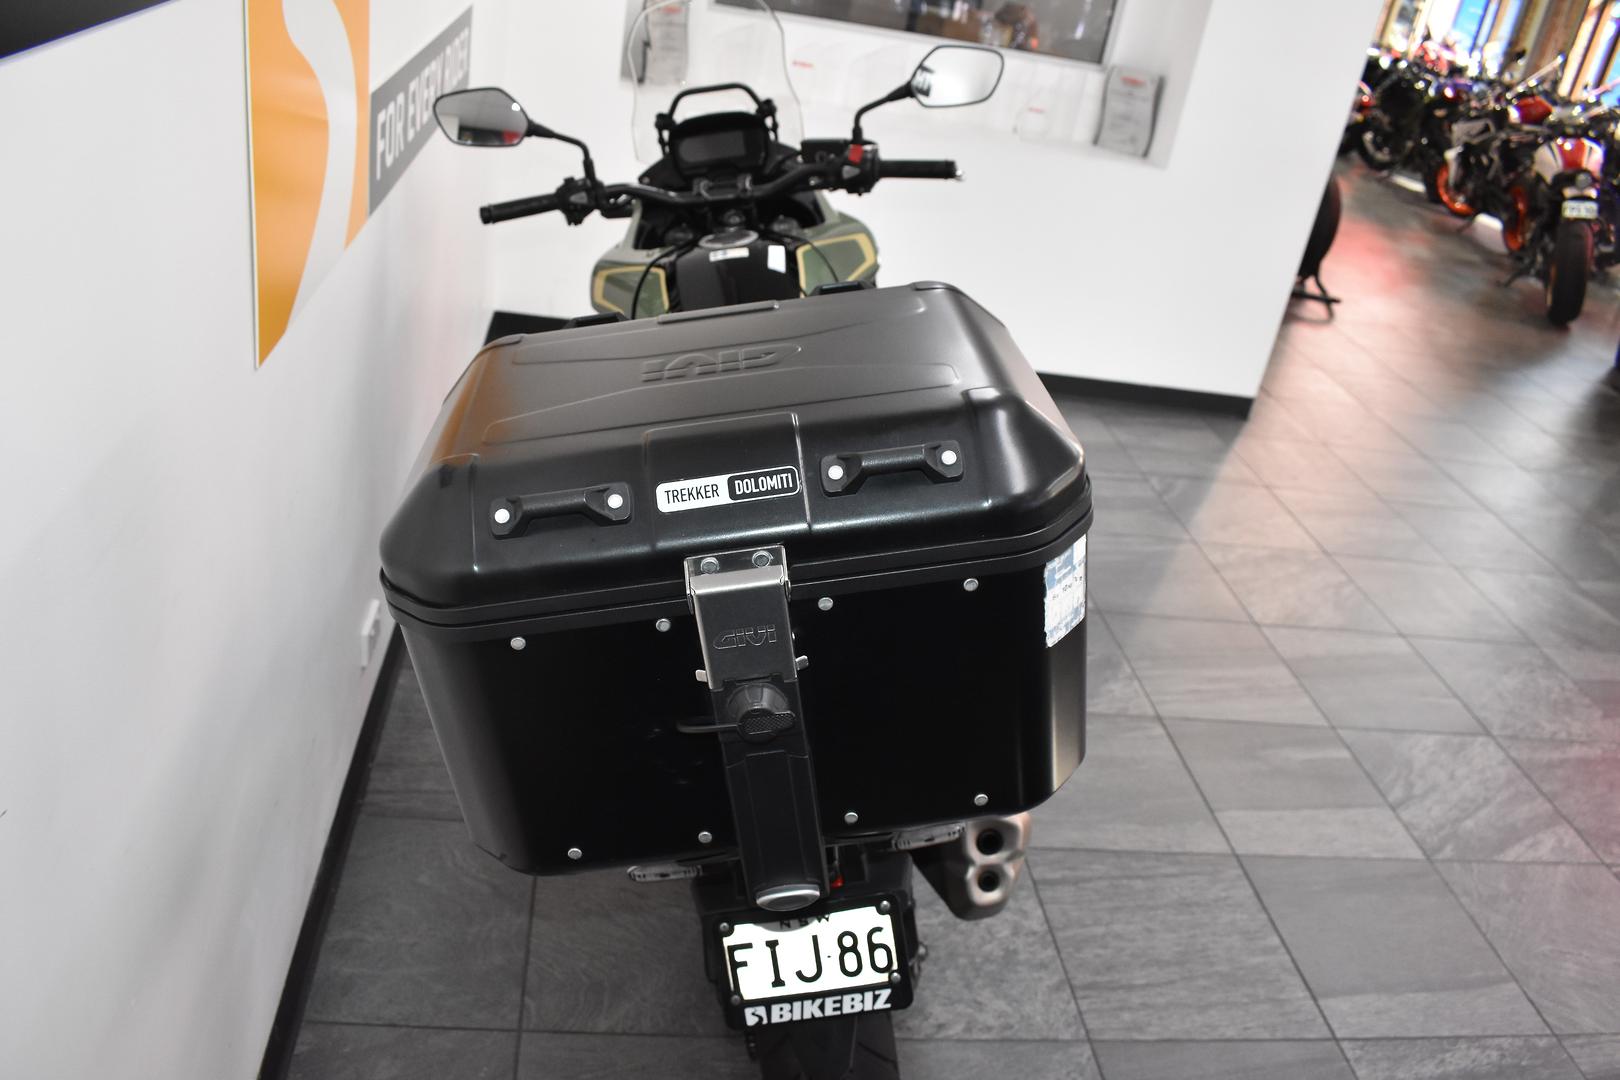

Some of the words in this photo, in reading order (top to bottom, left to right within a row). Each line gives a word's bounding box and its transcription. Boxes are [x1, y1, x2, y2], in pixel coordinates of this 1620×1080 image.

[376, 91, 406, 181] FOR
[664, 484, 720, 505] TREKKER
[734, 472, 793, 495] DOLOMITI
[713, 624, 777, 650] GIVI
[770, 988, 892, 1024] BIKEBIZ
